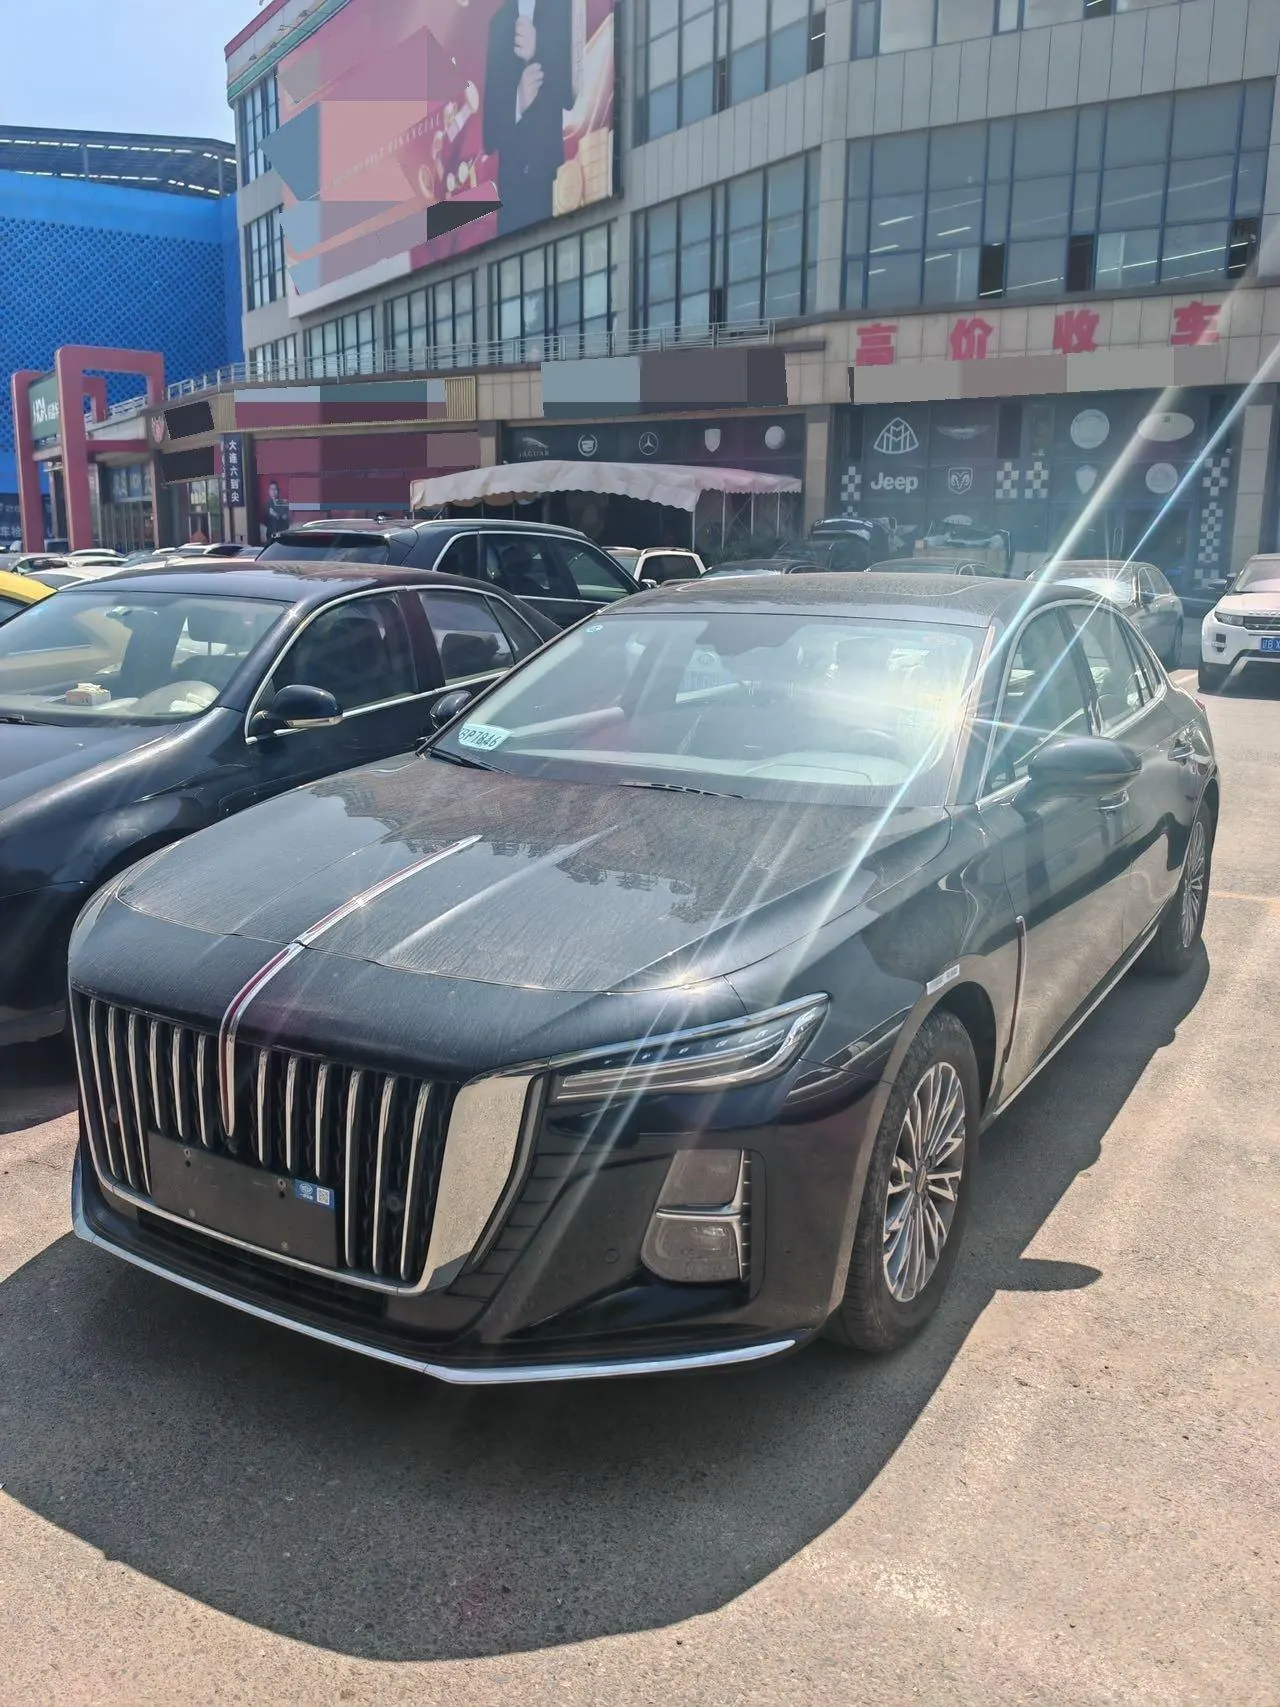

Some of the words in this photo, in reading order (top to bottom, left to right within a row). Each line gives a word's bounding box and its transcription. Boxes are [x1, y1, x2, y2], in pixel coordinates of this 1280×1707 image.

[856, 301, 1221, 366] 高价收车
[519, 449, 550, 459] JAGUAR
[870, 472, 919, 494] Jeep
